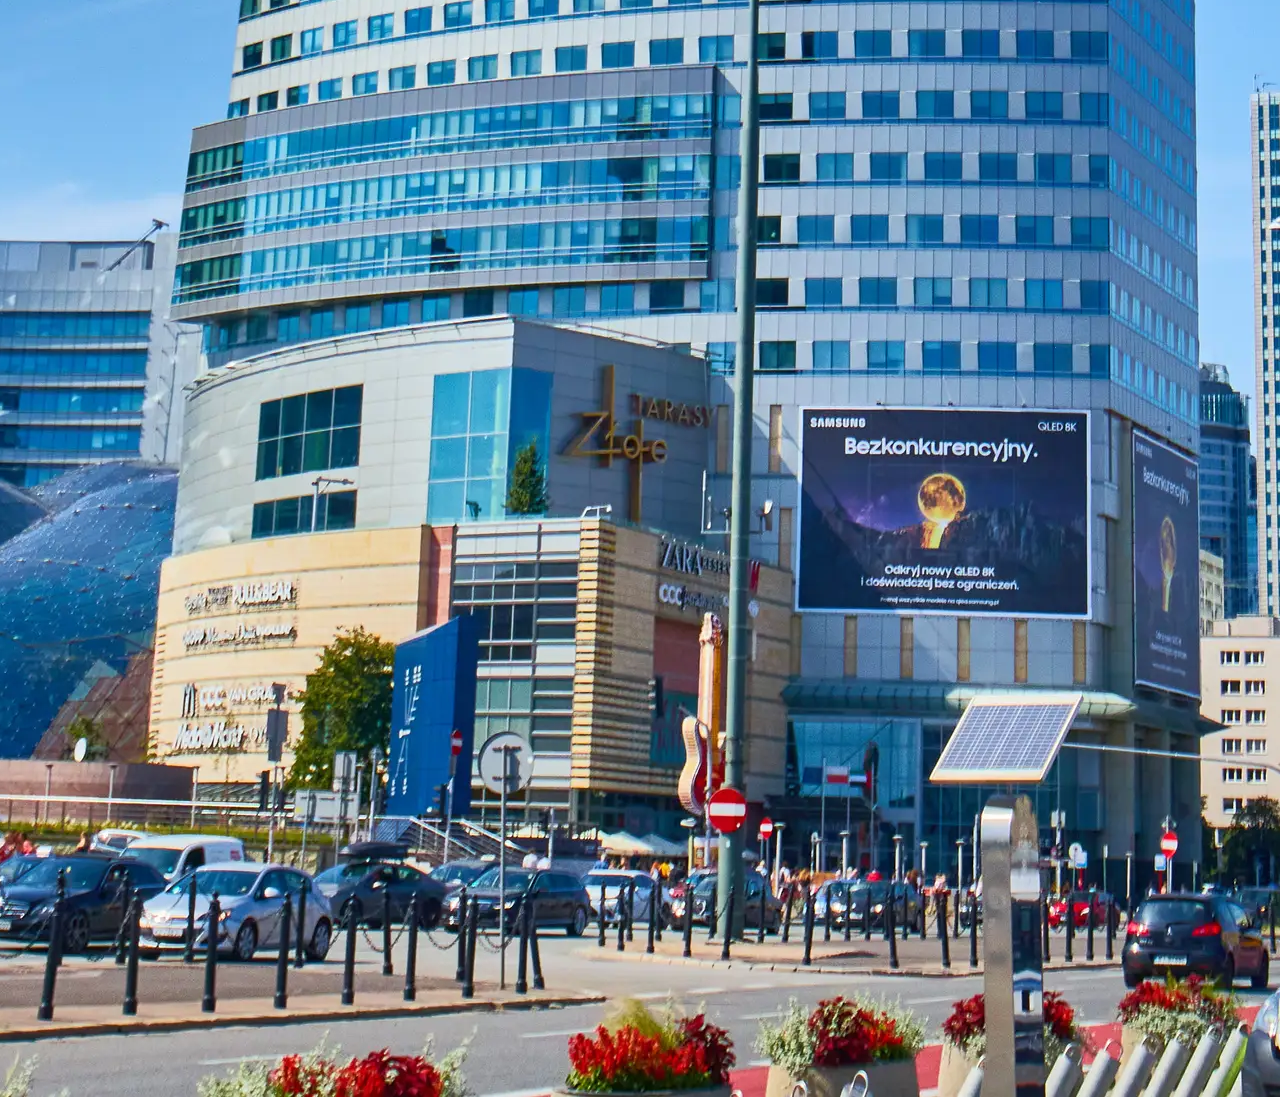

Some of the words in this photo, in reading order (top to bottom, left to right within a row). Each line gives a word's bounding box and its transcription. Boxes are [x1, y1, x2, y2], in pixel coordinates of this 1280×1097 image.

[629, 393, 714, 428] TARASY
[810, 417, 866, 428] SAMSUNG
[1037, 421, 1063, 432] QLED
[1064, 422, 1077, 432] 8K
[844, 436, 1039, 462] Bezkonkurencyjny.
[661, 541, 703, 576] ZARA
[703, 557, 731, 575] RESERV
[884, 564, 920, 577] Odkryj
[922, 566, 952, 578] nowy
[954, 567, 980, 577] QLED
[982, 567, 995, 577] 8K
[865, 576, 934, 591] doświadczaj
[935, 578, 955, 589] bez
[956, 579, 1020, 592] ograniczeń.
[659, 583, 682, 606] CCC
